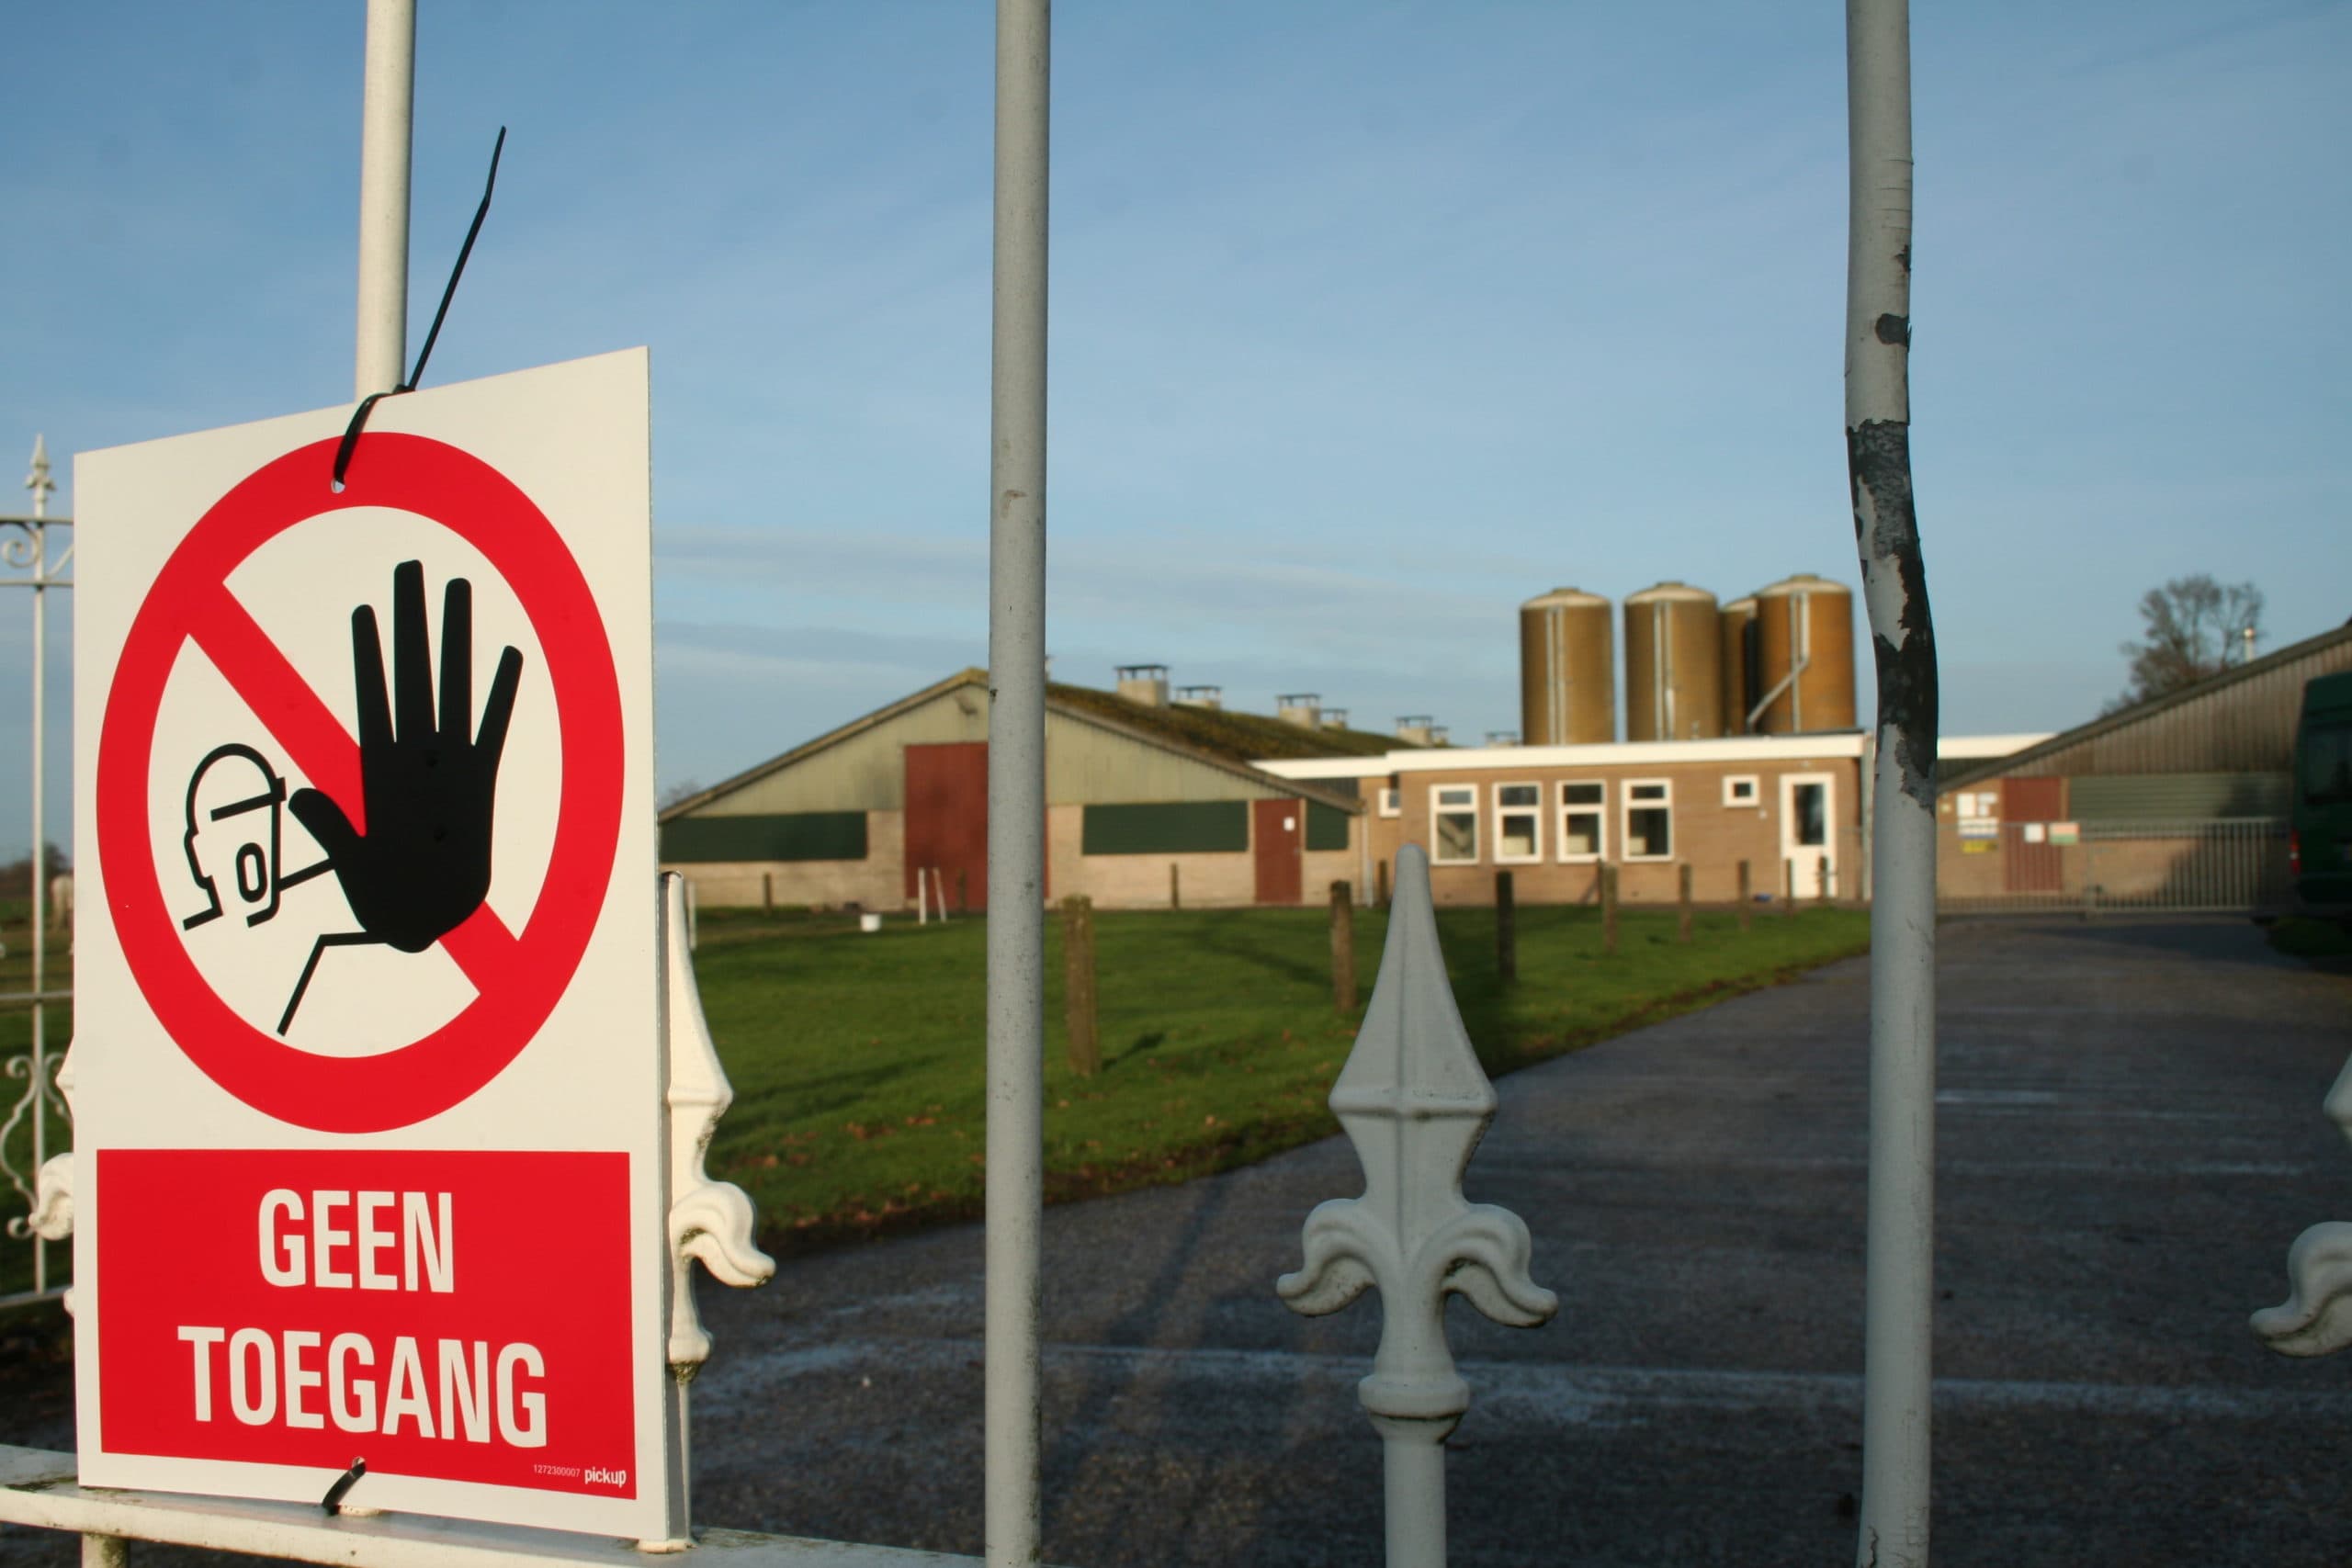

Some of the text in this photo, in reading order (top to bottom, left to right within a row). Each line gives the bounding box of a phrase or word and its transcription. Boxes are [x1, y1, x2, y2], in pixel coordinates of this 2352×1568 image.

[258, 1189, 454, 1293] GEEN
[177, 1325, 548, 1448] TOEGANG
[584, 1467, 627, 1488] pickup
